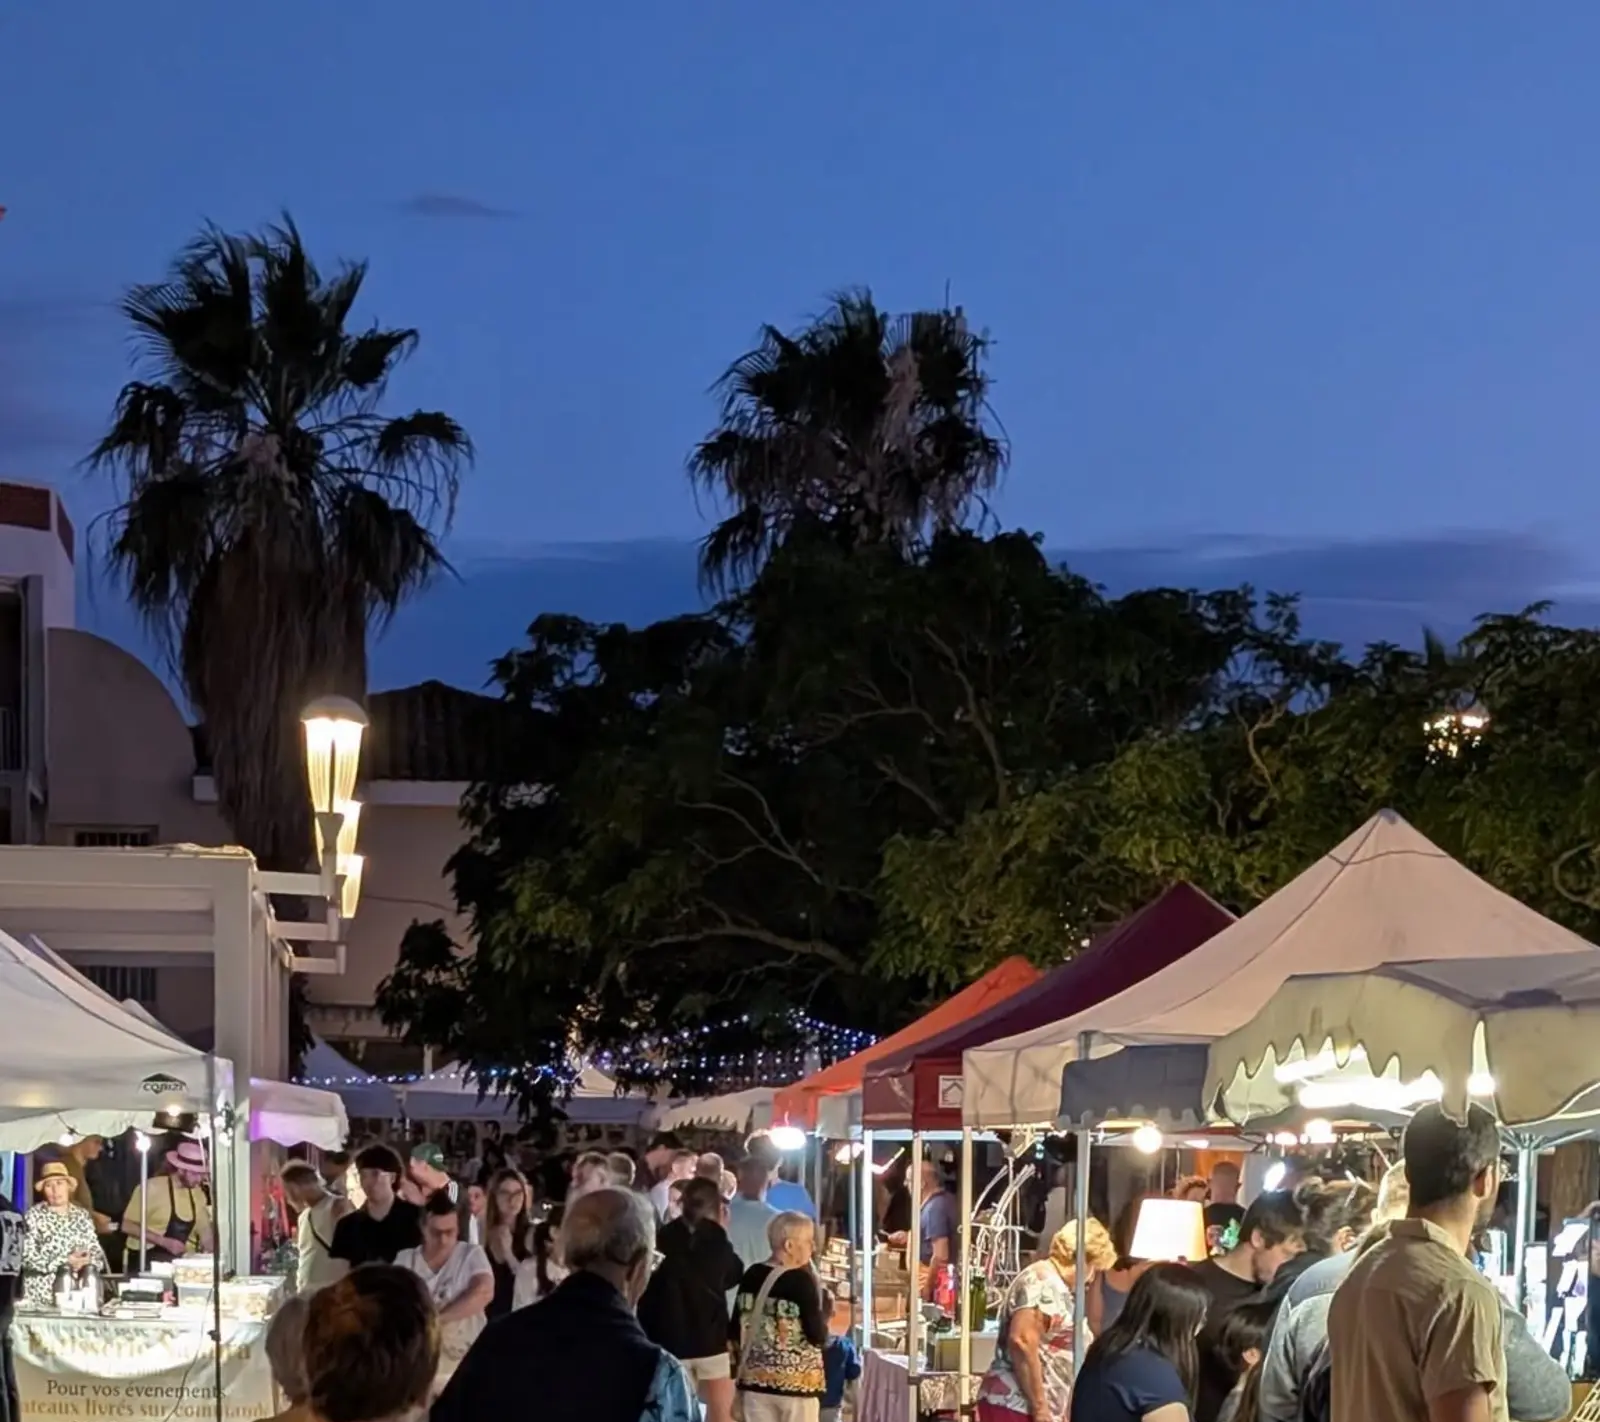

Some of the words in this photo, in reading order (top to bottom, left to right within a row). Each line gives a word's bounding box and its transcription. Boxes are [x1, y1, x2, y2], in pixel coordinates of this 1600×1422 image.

[46, 1379, 88, 1397] Pour
[92, 1384, 120, 1398] vos
[85, 1398, 134, 1417] livrés
[140, 1403, 166, 1418] sur
